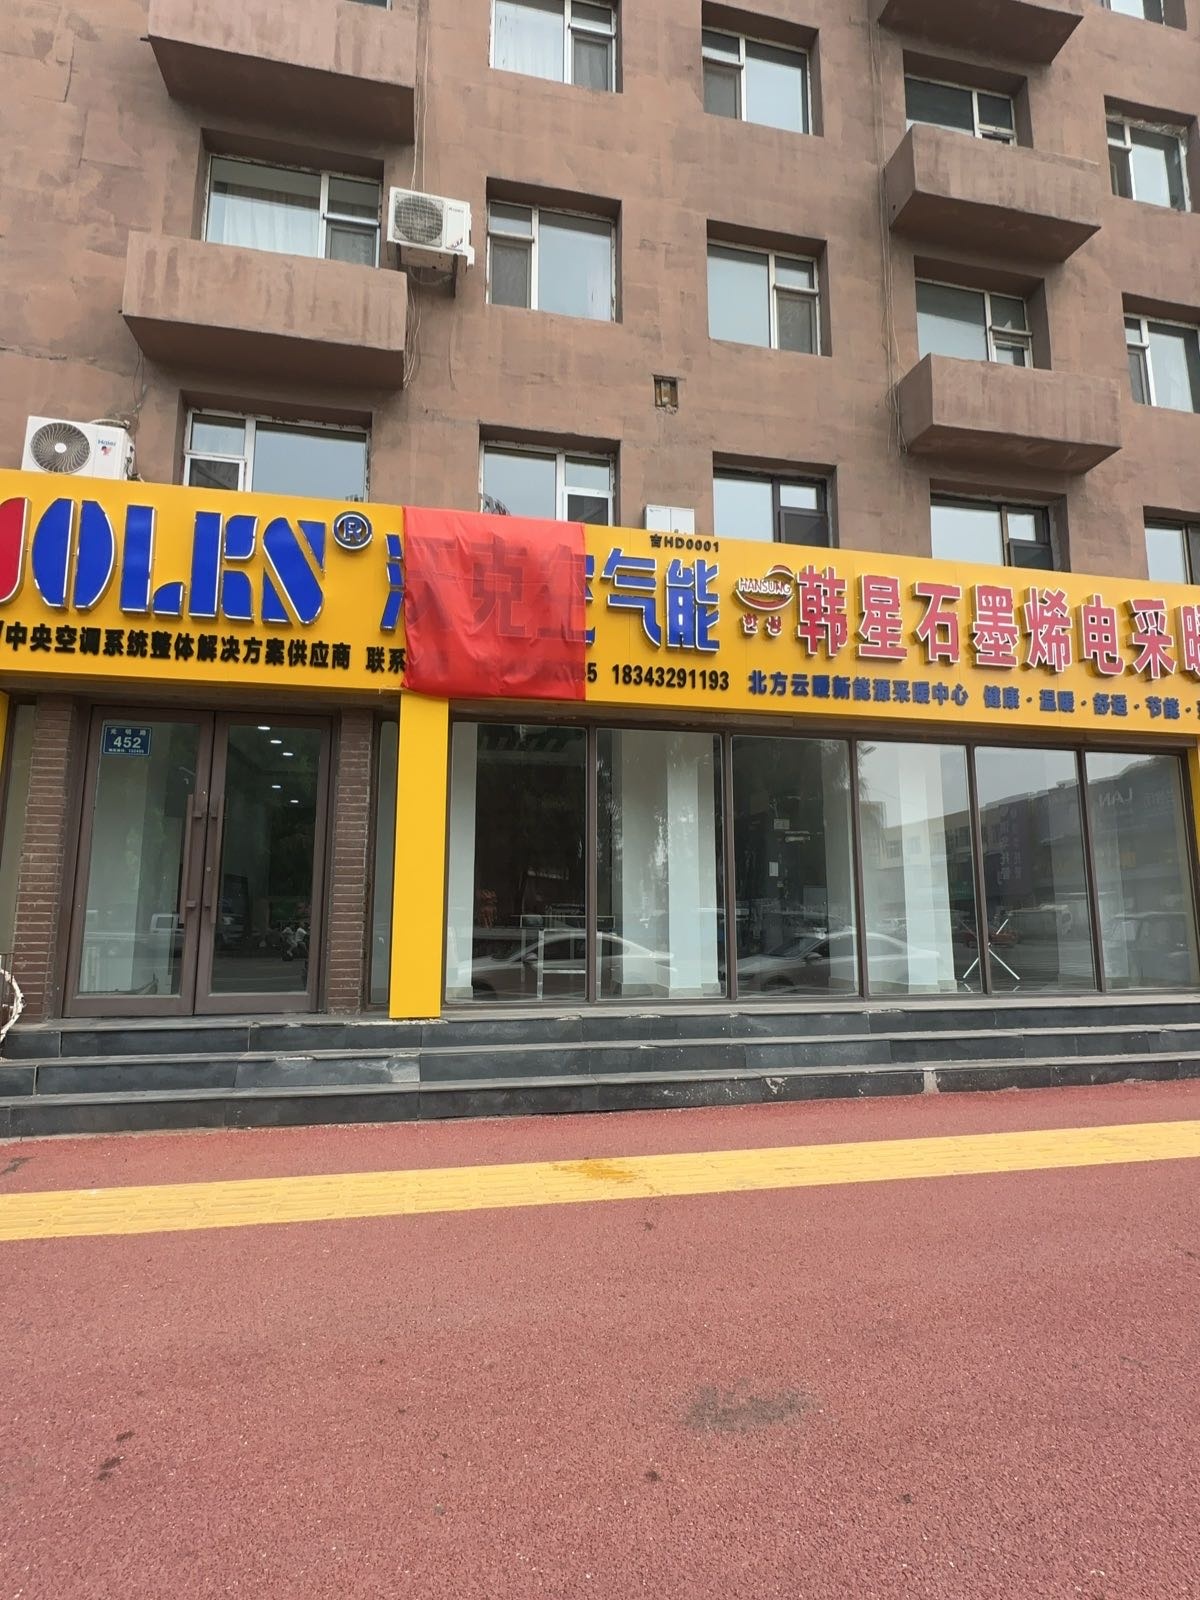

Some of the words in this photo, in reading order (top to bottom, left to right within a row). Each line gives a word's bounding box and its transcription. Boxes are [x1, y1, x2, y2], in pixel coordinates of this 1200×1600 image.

[738, 577, 793, 595] HANSUNG
[0, 620, 352, 670] 中央空调系统整体解决方案供应商
[611, 664, 730, 691] 18343291193
[113, 735, 142, 748] 452
